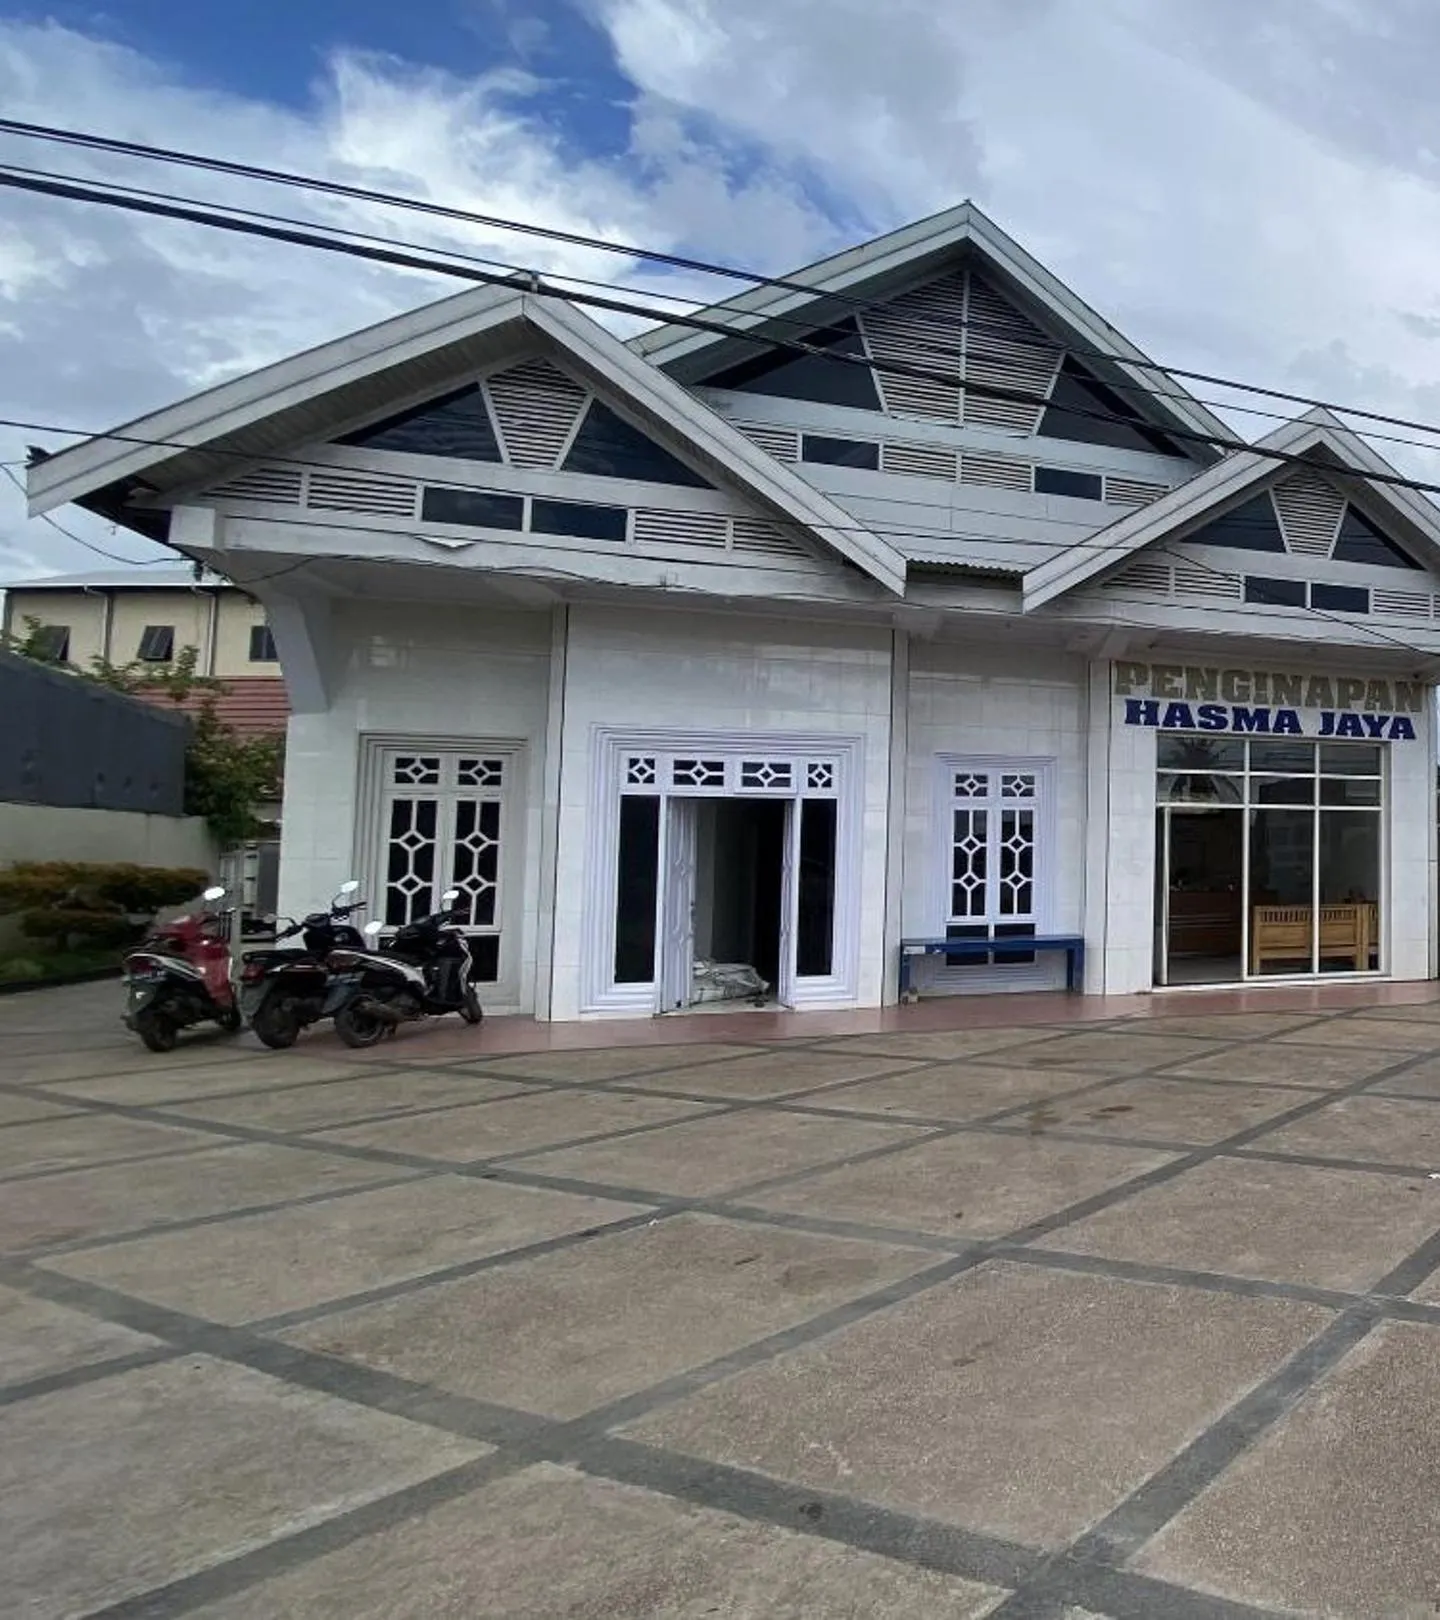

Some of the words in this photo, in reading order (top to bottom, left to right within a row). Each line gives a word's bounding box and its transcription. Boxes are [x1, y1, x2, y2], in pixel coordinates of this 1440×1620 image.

[1114, 660, 1426, 712] PENGINAPAN
[1125, 699, 1303, 734] HASMA
[1318, 711, 1416, 740] JAYA
